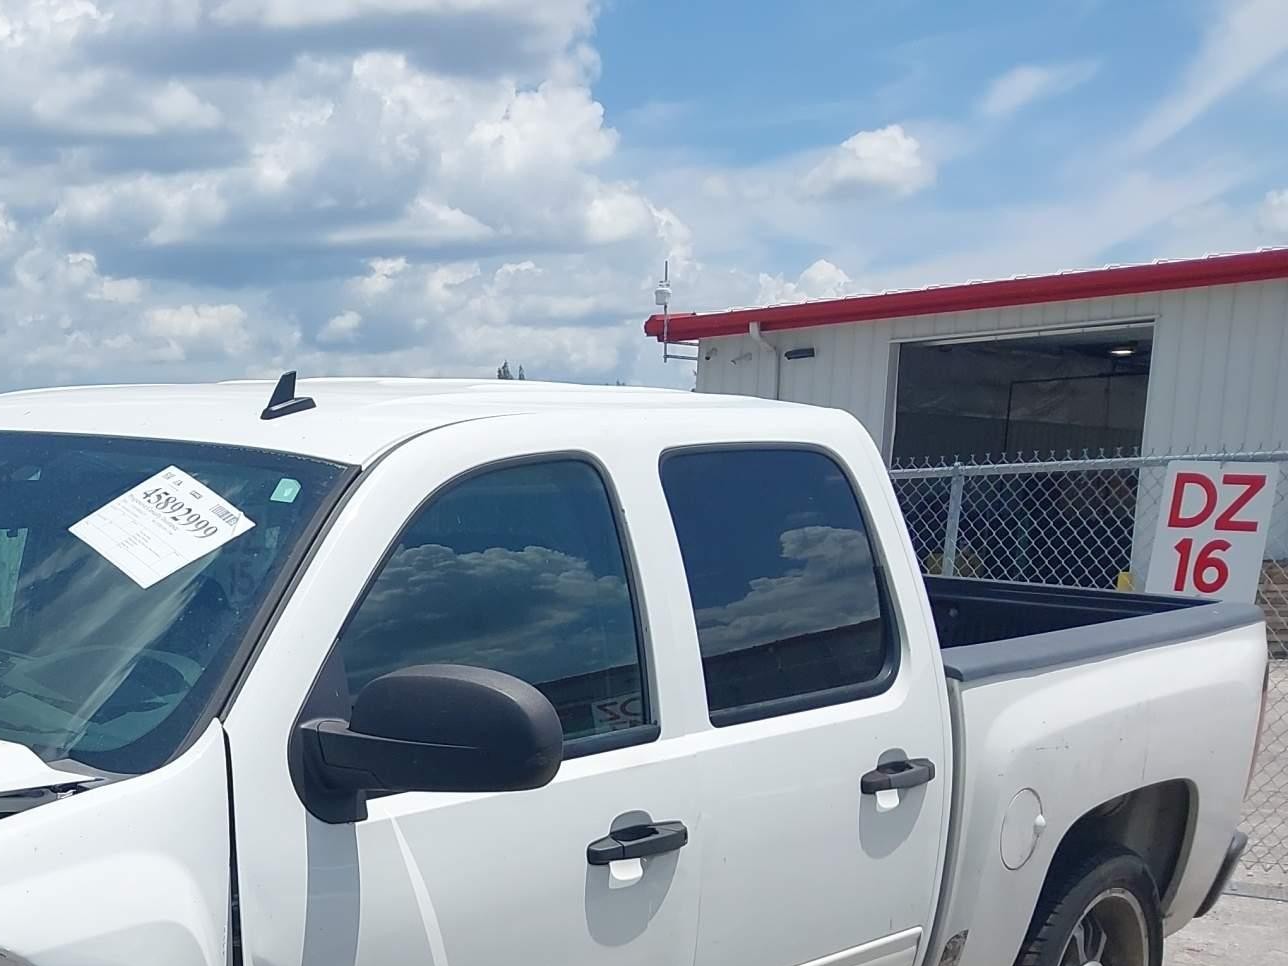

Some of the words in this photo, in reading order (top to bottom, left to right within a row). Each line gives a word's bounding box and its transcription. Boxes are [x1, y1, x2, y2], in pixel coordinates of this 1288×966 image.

[142, 487, 219, 539] 45892999
[1167, 472, 1268, 532] DZ
[1173, 537, 1233, 594] 16
